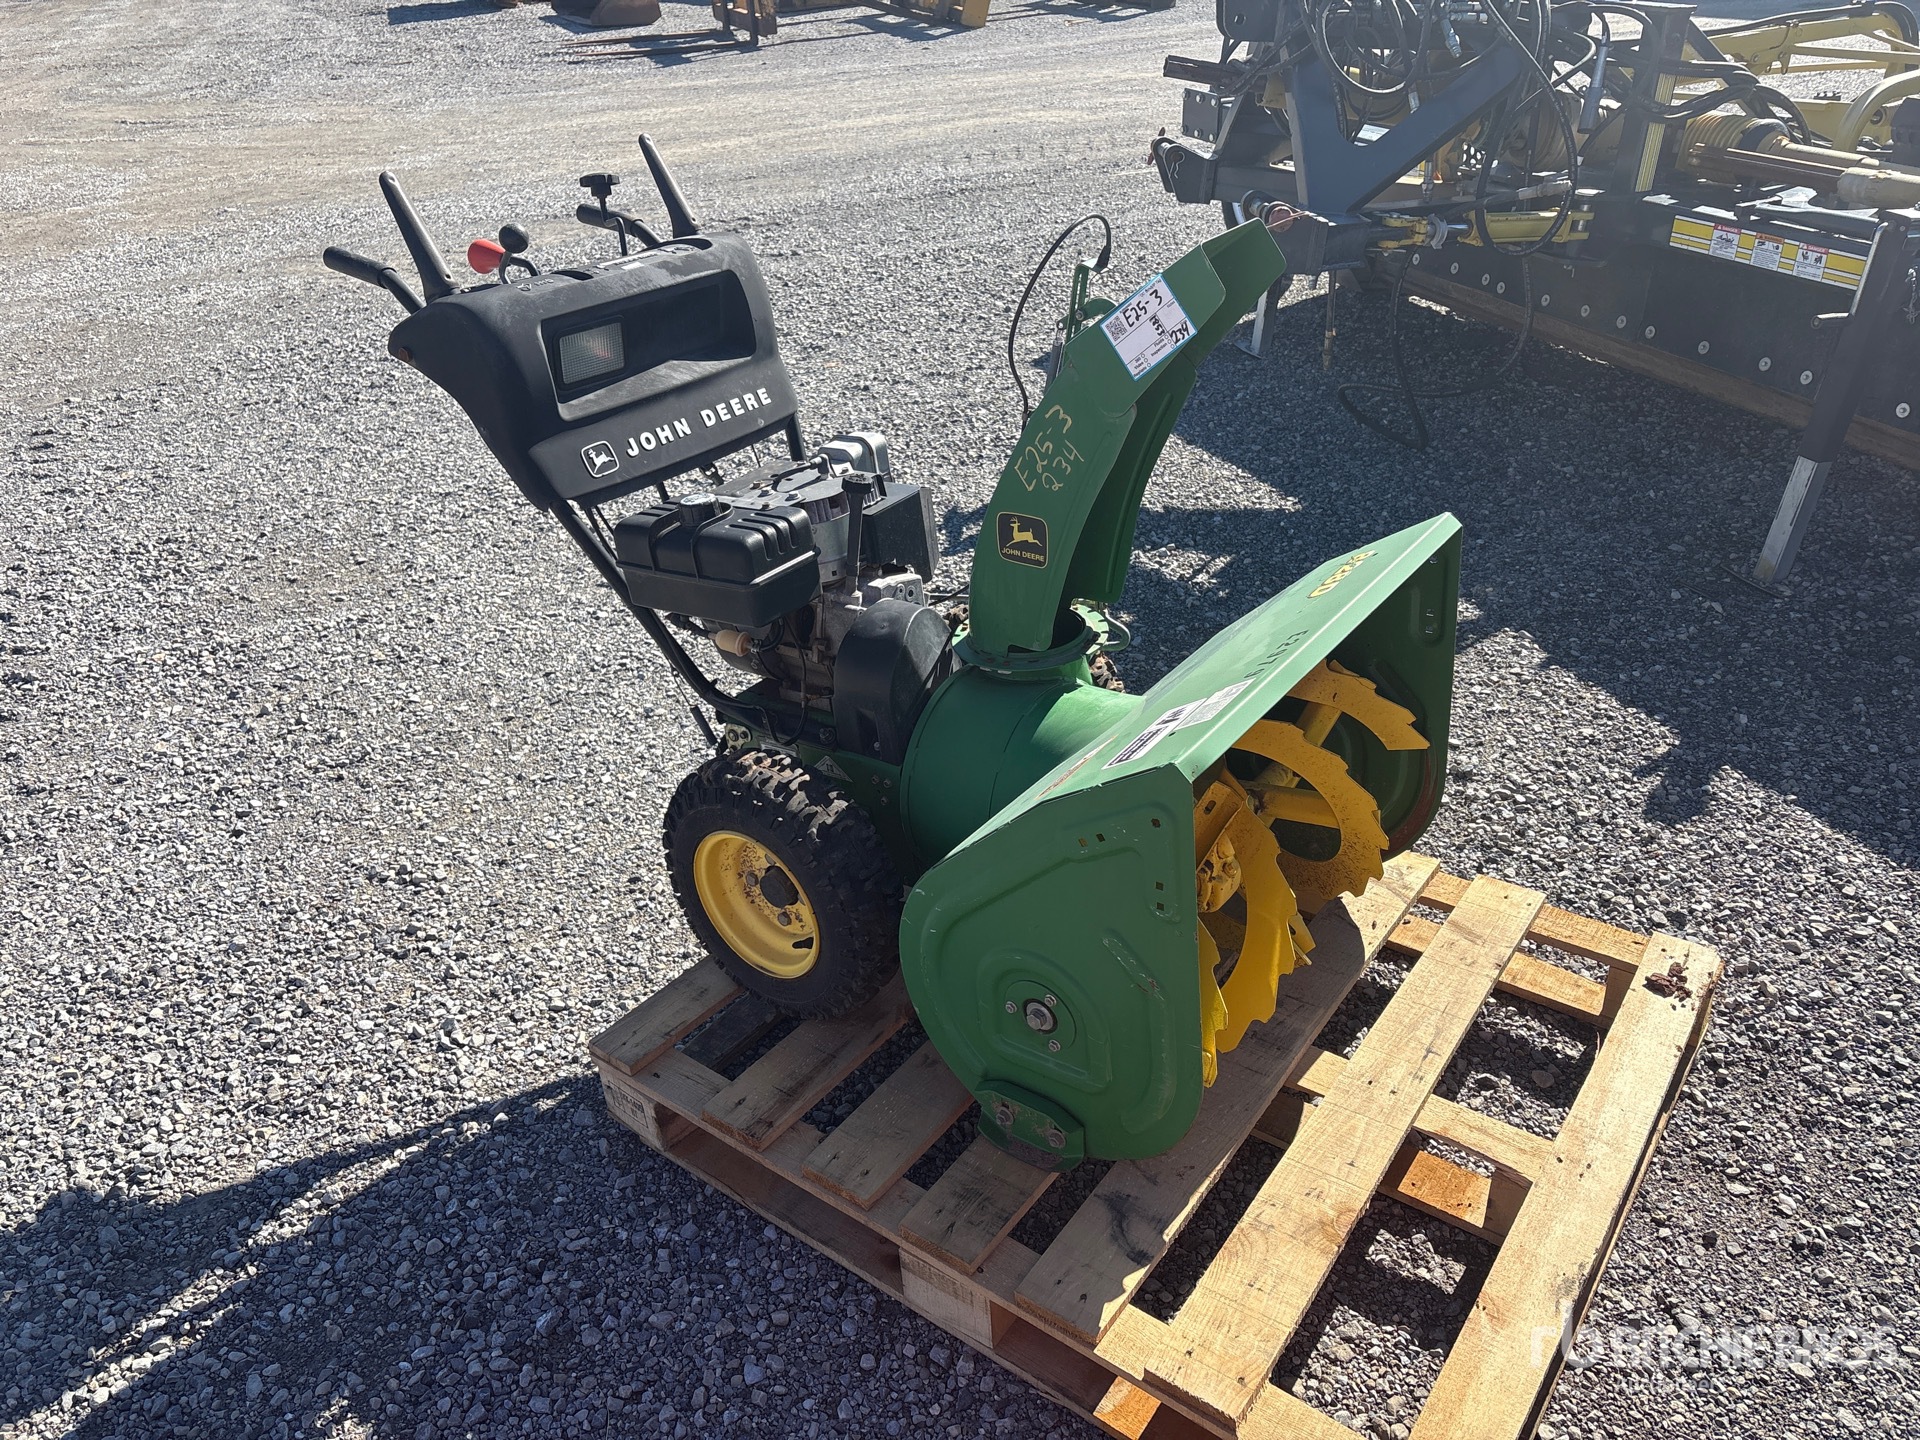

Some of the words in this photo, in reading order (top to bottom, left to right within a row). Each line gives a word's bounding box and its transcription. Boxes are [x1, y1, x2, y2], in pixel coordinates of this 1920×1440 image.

[1169, 322, 1190, 344] 234
[627, 417, 692, 457] JOHN
[700, 387, 772, 428] DEERE
[1014, 404, 1073, 491] E25-3
[1041, 439, 1085, 491] 234
[1001, 547, 1021, 557] JOHN
[1022, 551, 1045, 562] DEERE
